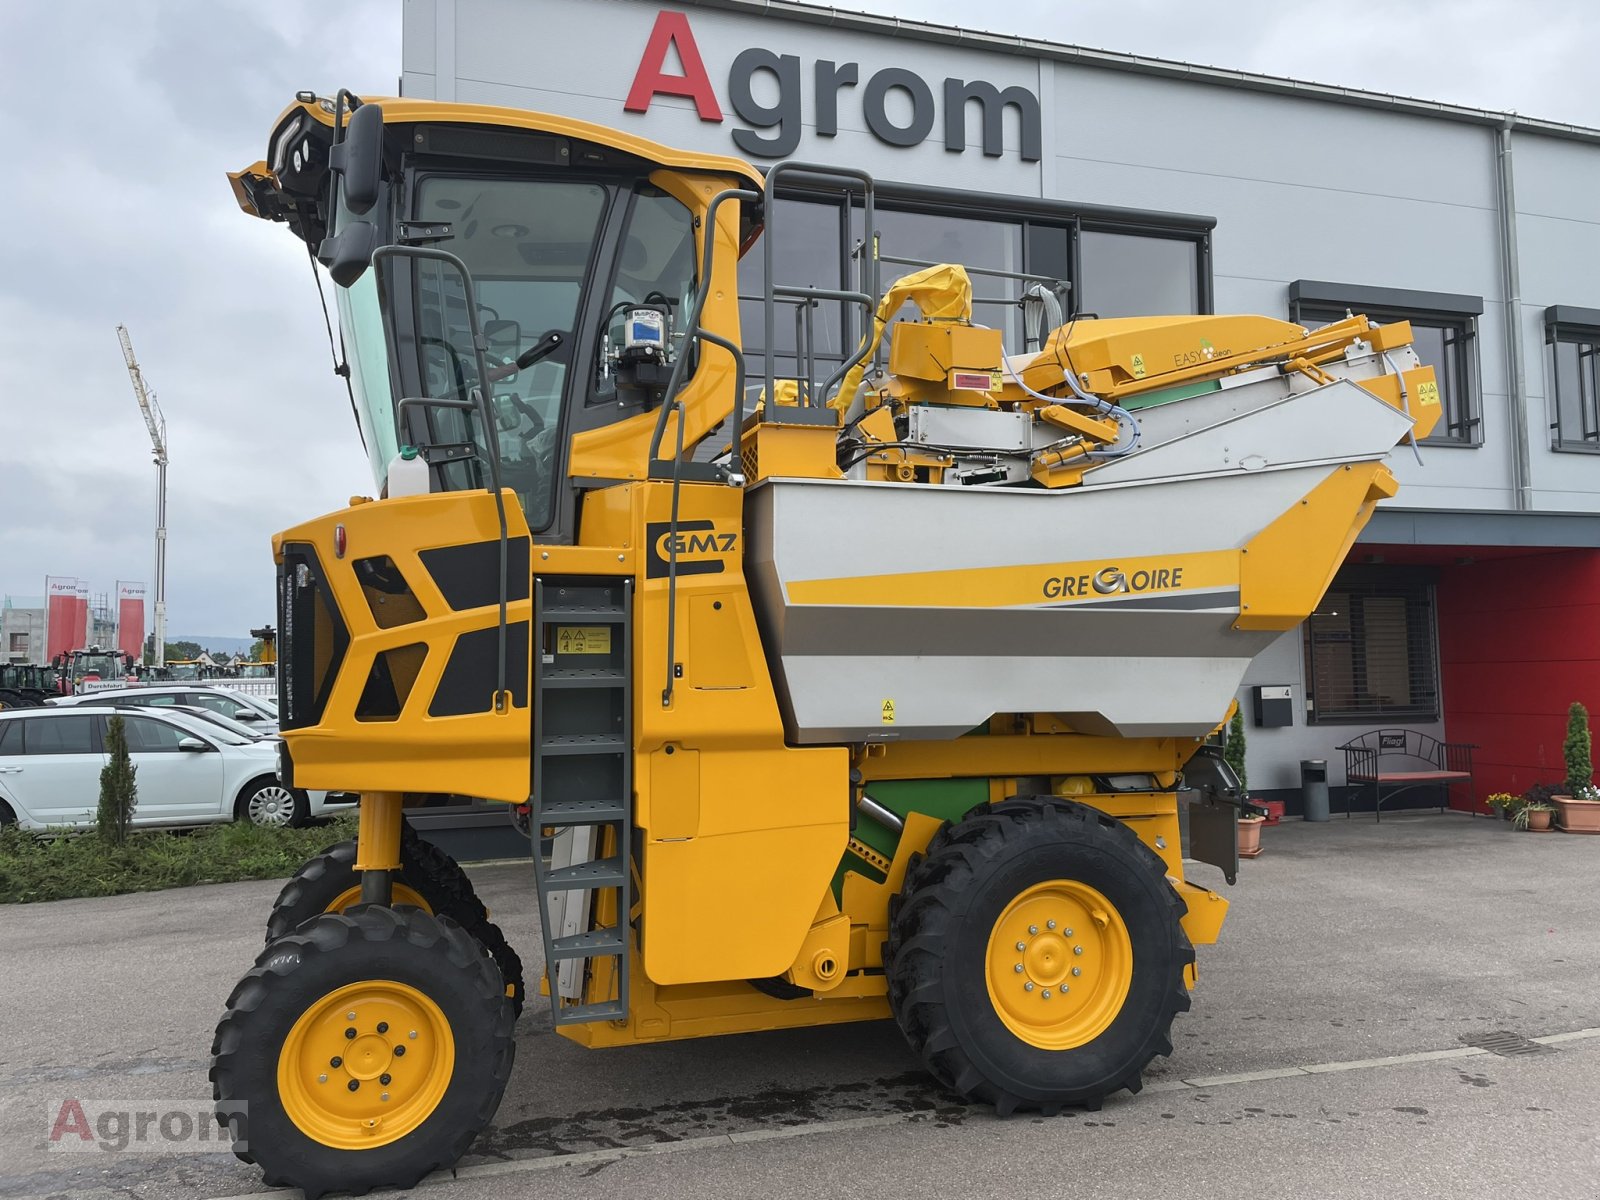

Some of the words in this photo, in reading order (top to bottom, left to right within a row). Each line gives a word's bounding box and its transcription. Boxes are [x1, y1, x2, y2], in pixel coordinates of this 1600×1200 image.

[623, 9, 1041, 162] Agrom
[1174, 349, 1202, 367] EASY
[1042, 566, 1183, 599] GREGOIRE
[1283, 688, 1290, 697] 4
